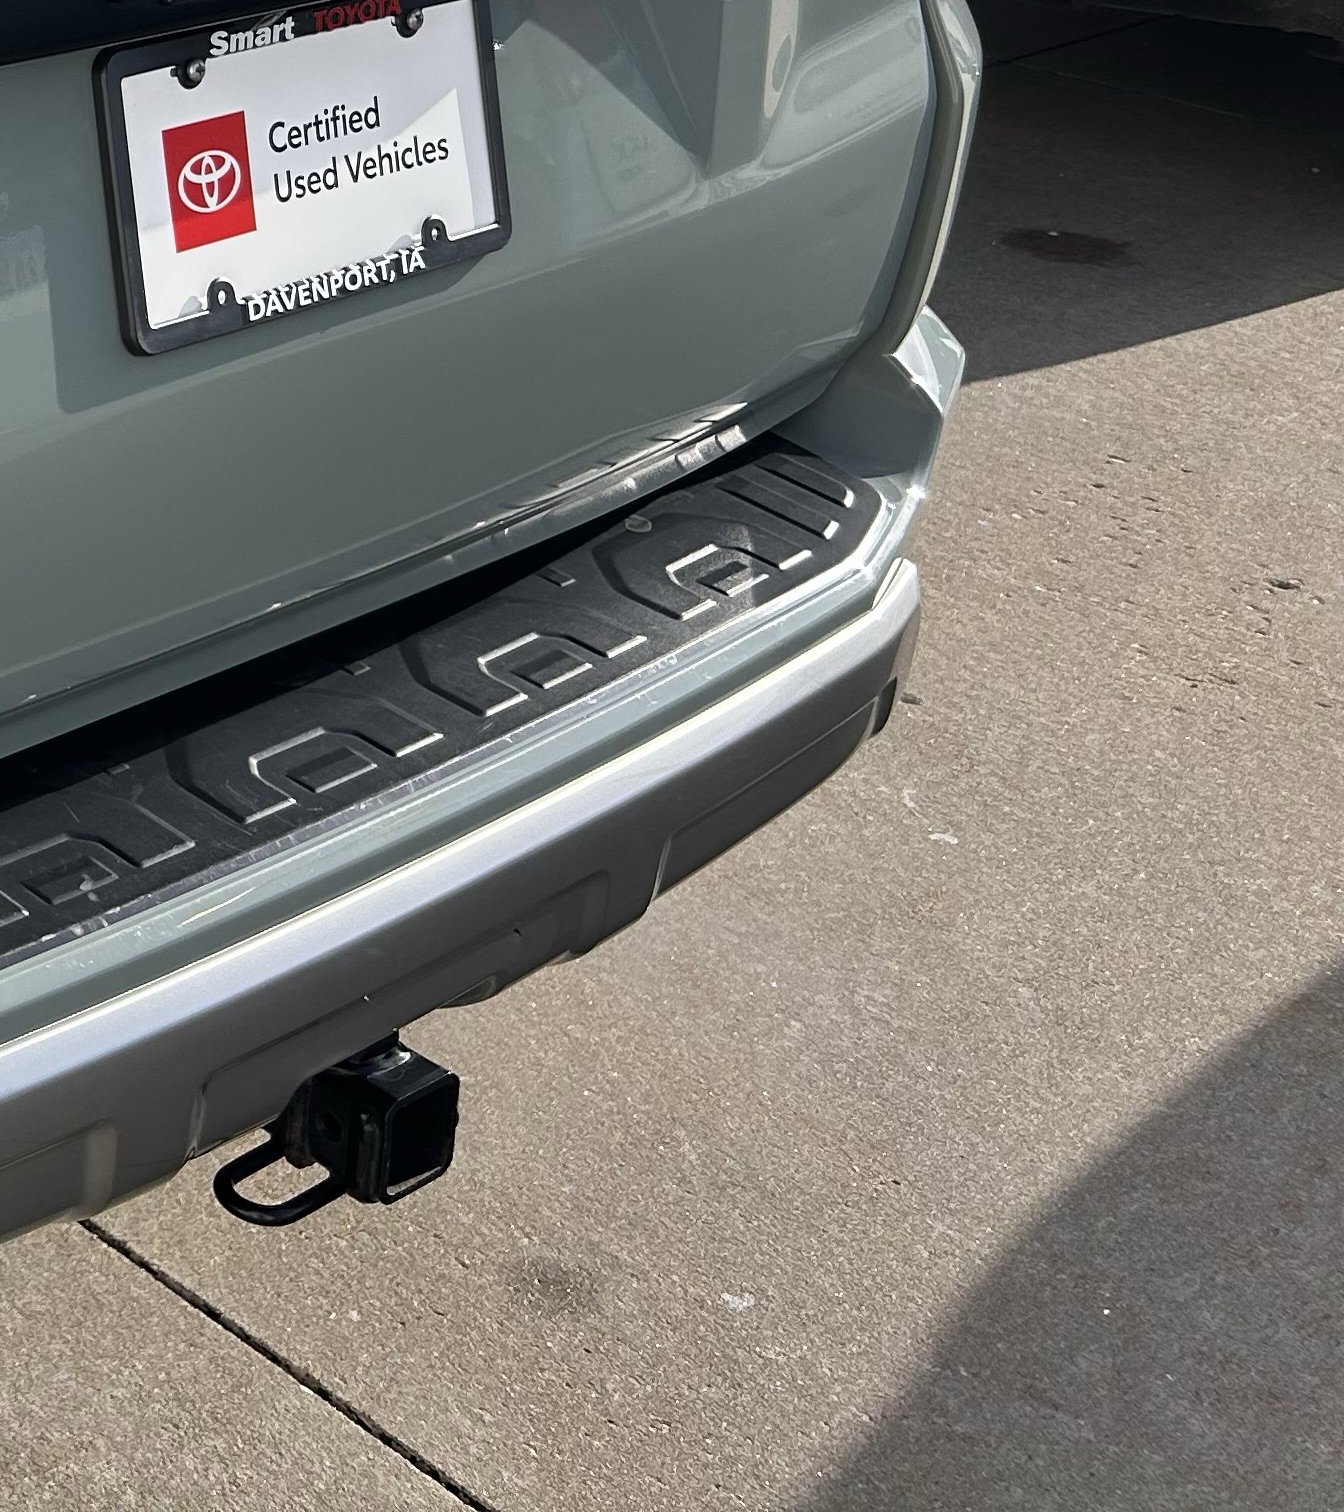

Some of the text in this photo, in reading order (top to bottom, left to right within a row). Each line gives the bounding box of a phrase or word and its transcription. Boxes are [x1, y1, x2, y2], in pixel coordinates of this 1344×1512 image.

[210, 15, 295, 57] Smart
[268, 96, 381, 154] Certified
[273, 133, 450, 204] Used Vehicles
[247, 248, 427, 323] DAVENPORT, IA
